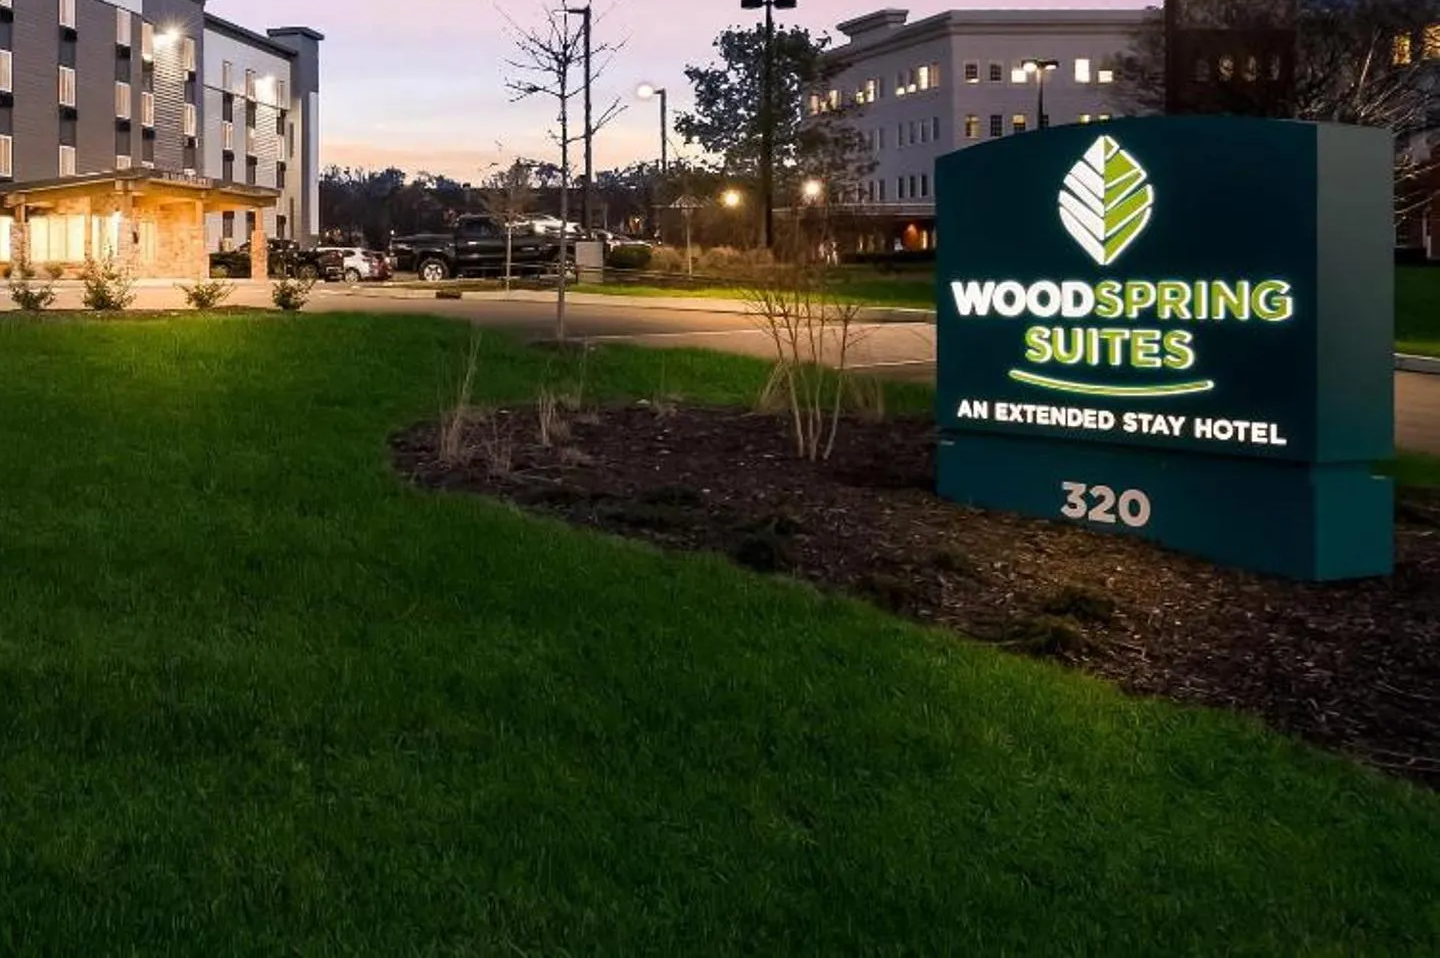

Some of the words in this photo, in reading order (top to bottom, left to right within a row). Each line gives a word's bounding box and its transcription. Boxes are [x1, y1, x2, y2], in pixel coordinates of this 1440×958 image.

[951, 279, 1294, 322] WOODSPRING
[1024, 325, 1196, 370] SUITES
[957, 400, 989, 419] AN
[994, 402, 1116, 430] EXTENDED
[1122, 412, 1186, 438] STAY
[1193, 418, 1288, 446] HOTEL
[1060, 481, 1152, 528] 320
